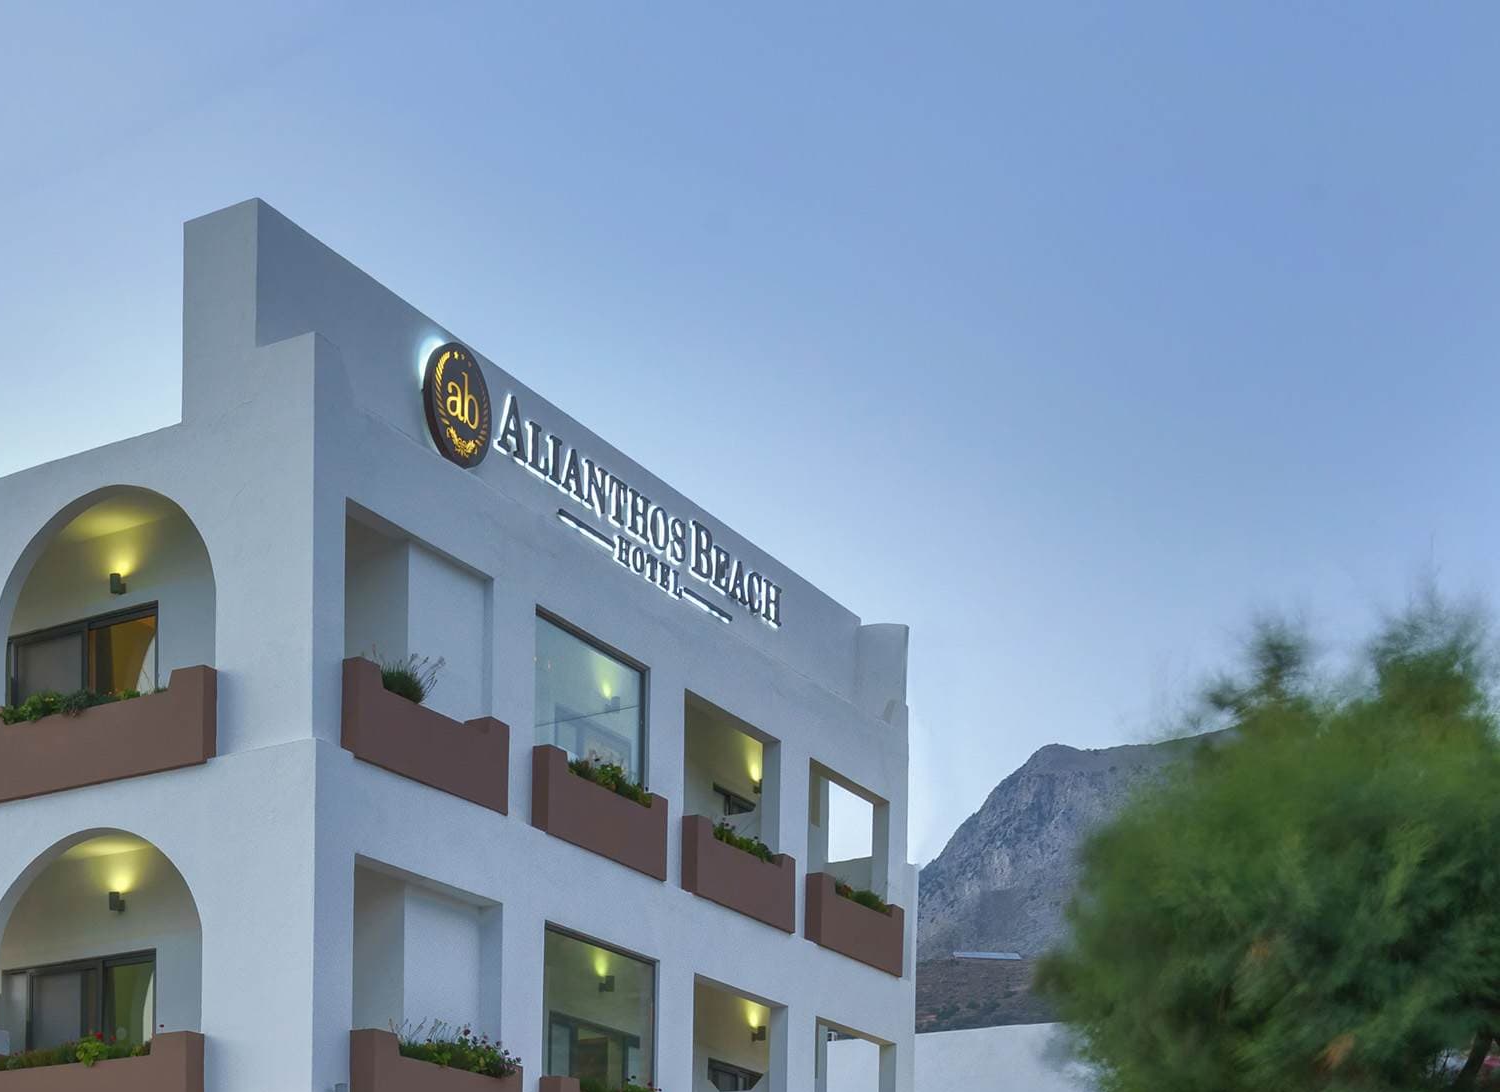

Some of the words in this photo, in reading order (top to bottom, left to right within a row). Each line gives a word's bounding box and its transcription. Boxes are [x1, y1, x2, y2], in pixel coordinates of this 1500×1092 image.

[446, 371, 479, 430] ab
[496, 394, 686, 563] ALIANTHOS
[690, 520, 782, 627] BEACH
[614, 535, 682, 600] HOTEL
